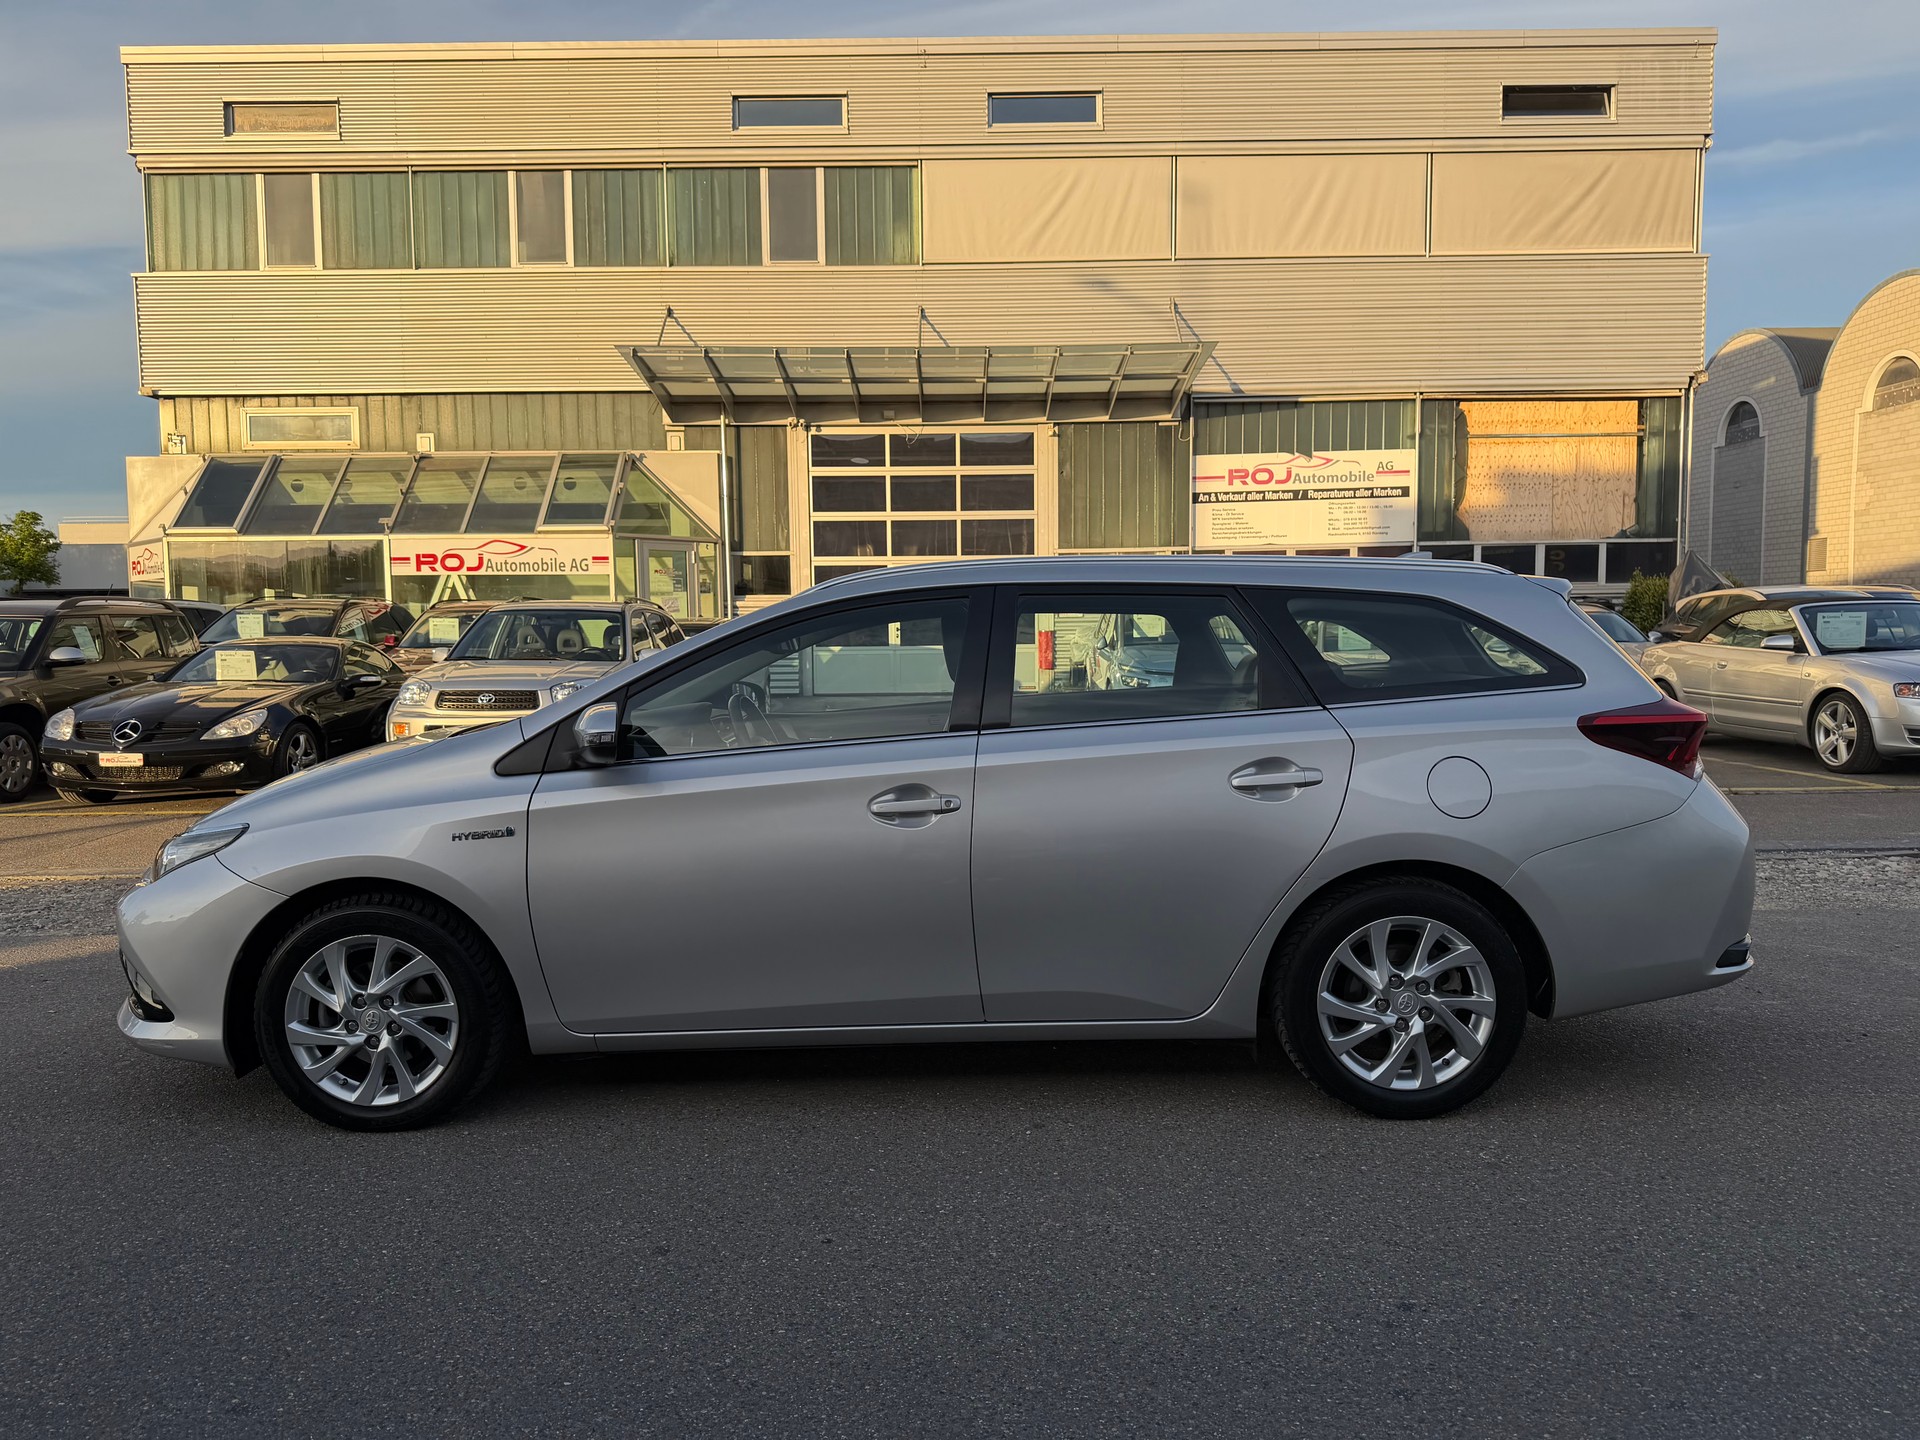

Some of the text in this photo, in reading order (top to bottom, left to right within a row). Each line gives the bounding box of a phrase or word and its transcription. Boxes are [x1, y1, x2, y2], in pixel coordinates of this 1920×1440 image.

[1228, 461, 1394, 486] ROJ Automobile AG
[1198, 487, 1402, 502] An & Verkauf aller Marken / Reparaturen aller Marken
[415, 553, 589, 572] ROJ Automobile AG
[451, 829, 506, 841] HYBRID
